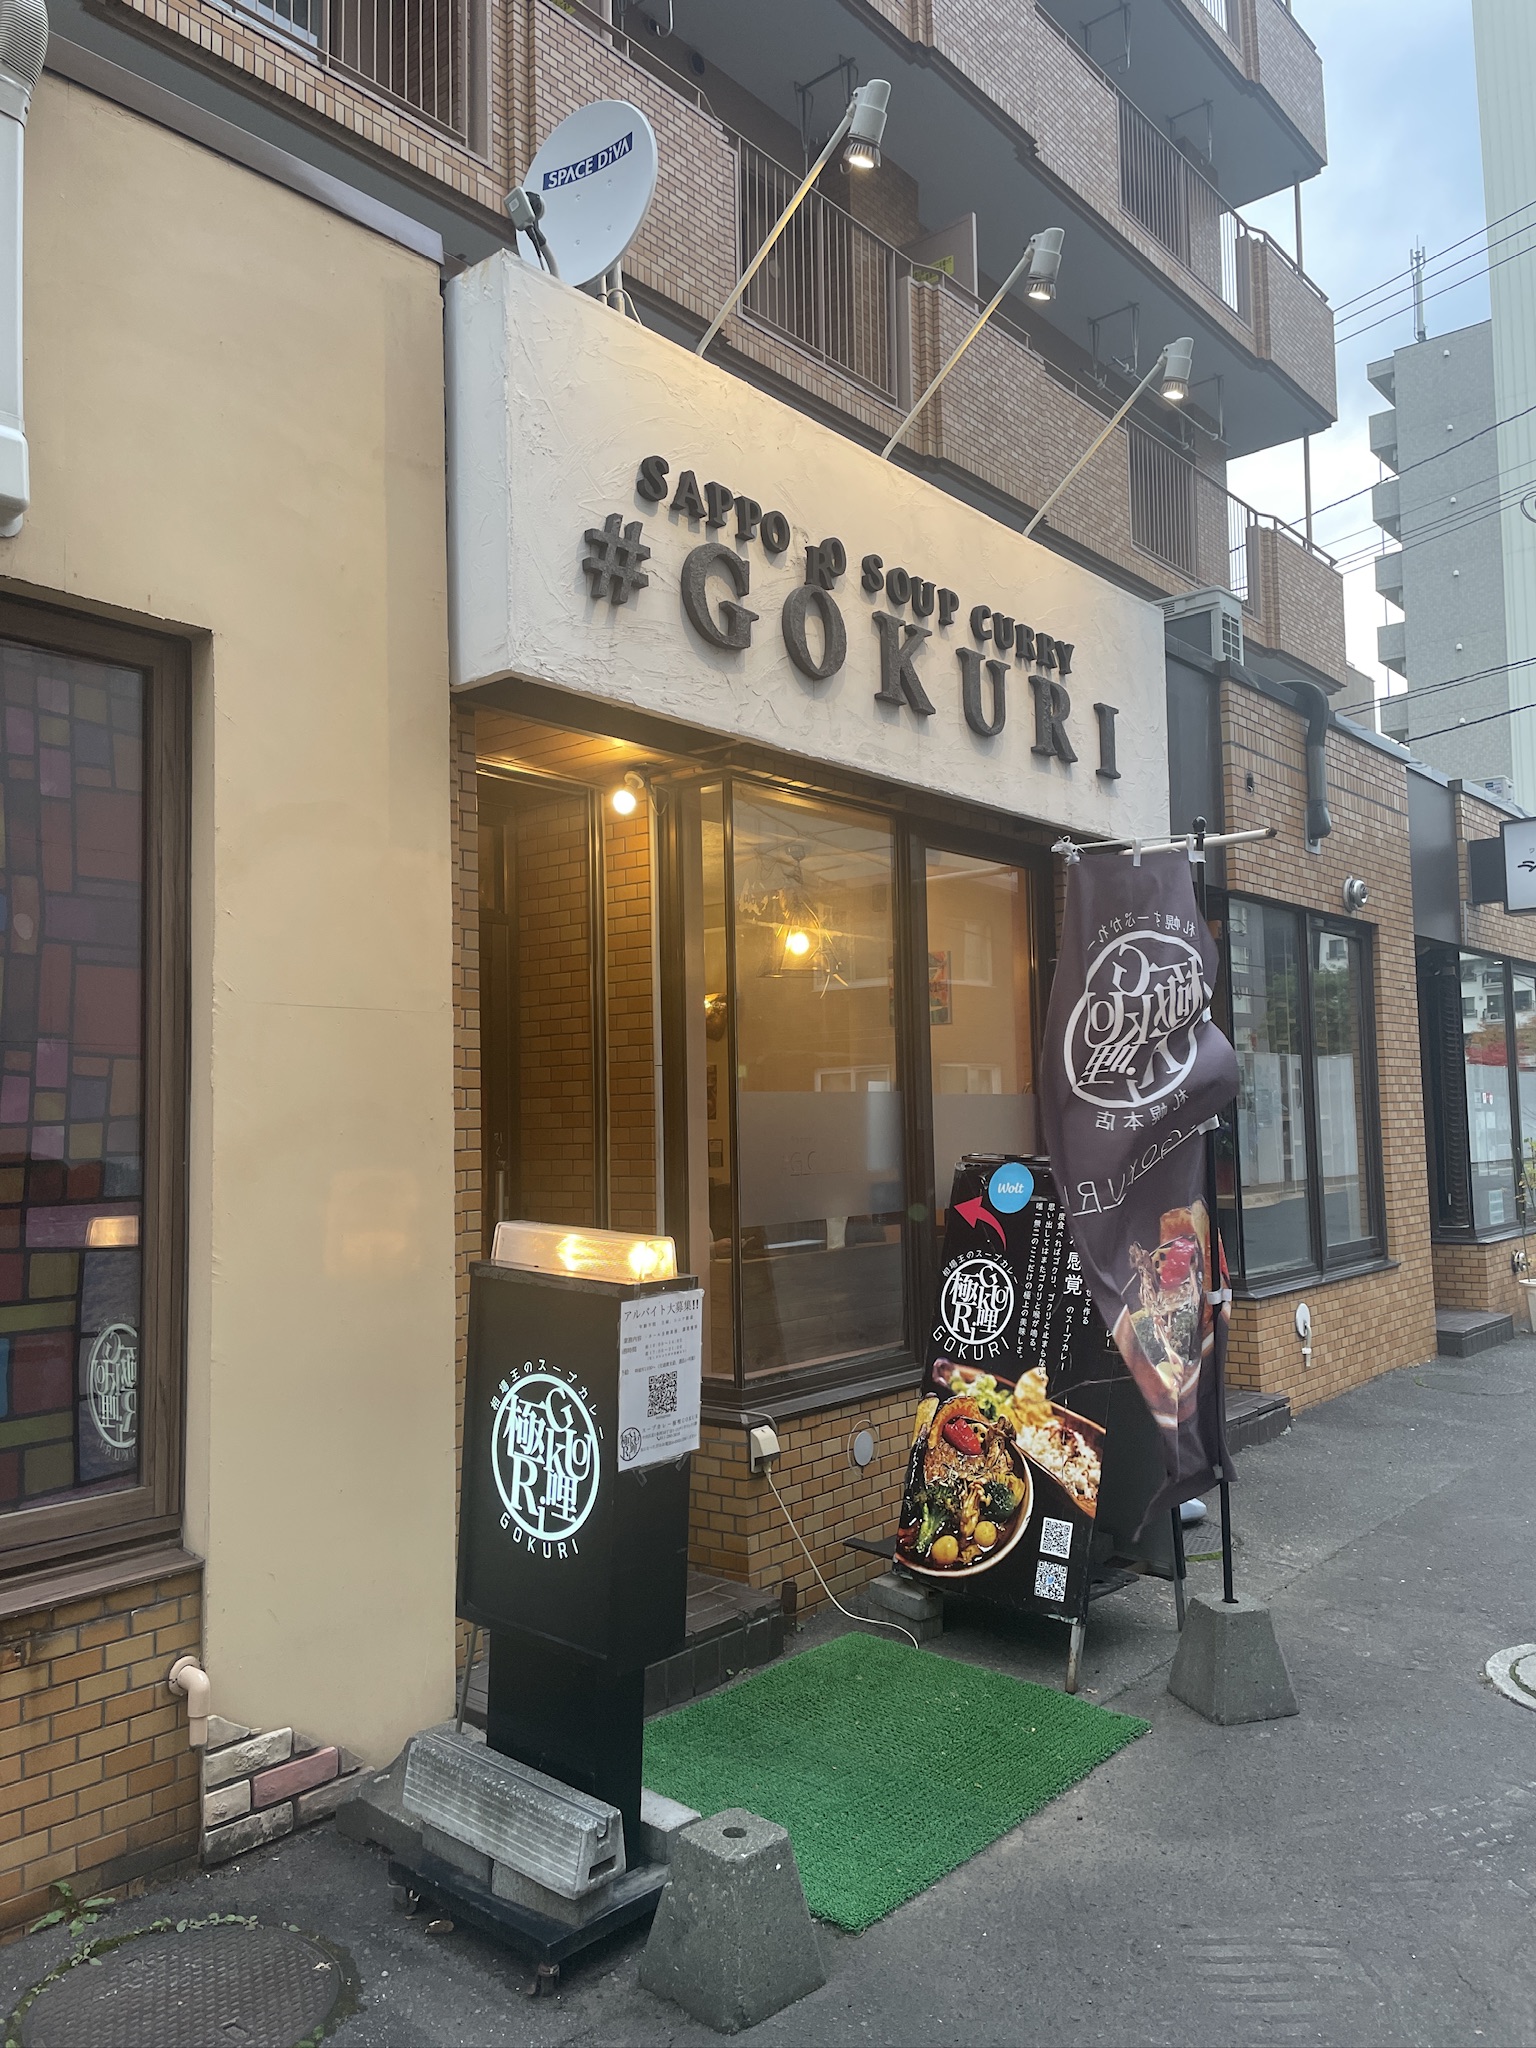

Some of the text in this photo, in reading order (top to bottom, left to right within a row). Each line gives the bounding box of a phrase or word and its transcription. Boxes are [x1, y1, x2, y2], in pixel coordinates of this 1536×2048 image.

[548, 157, 593, 188] SPACE
[861, 554, 960, 626] SOUP
[969, 604, 1075, 675] CURRY
[997, 1181, 1025, 1195] Wolt
[932, 1325, 1010, 1361] GOKURI
[499, 1511, 580, 1560] GOKURI
